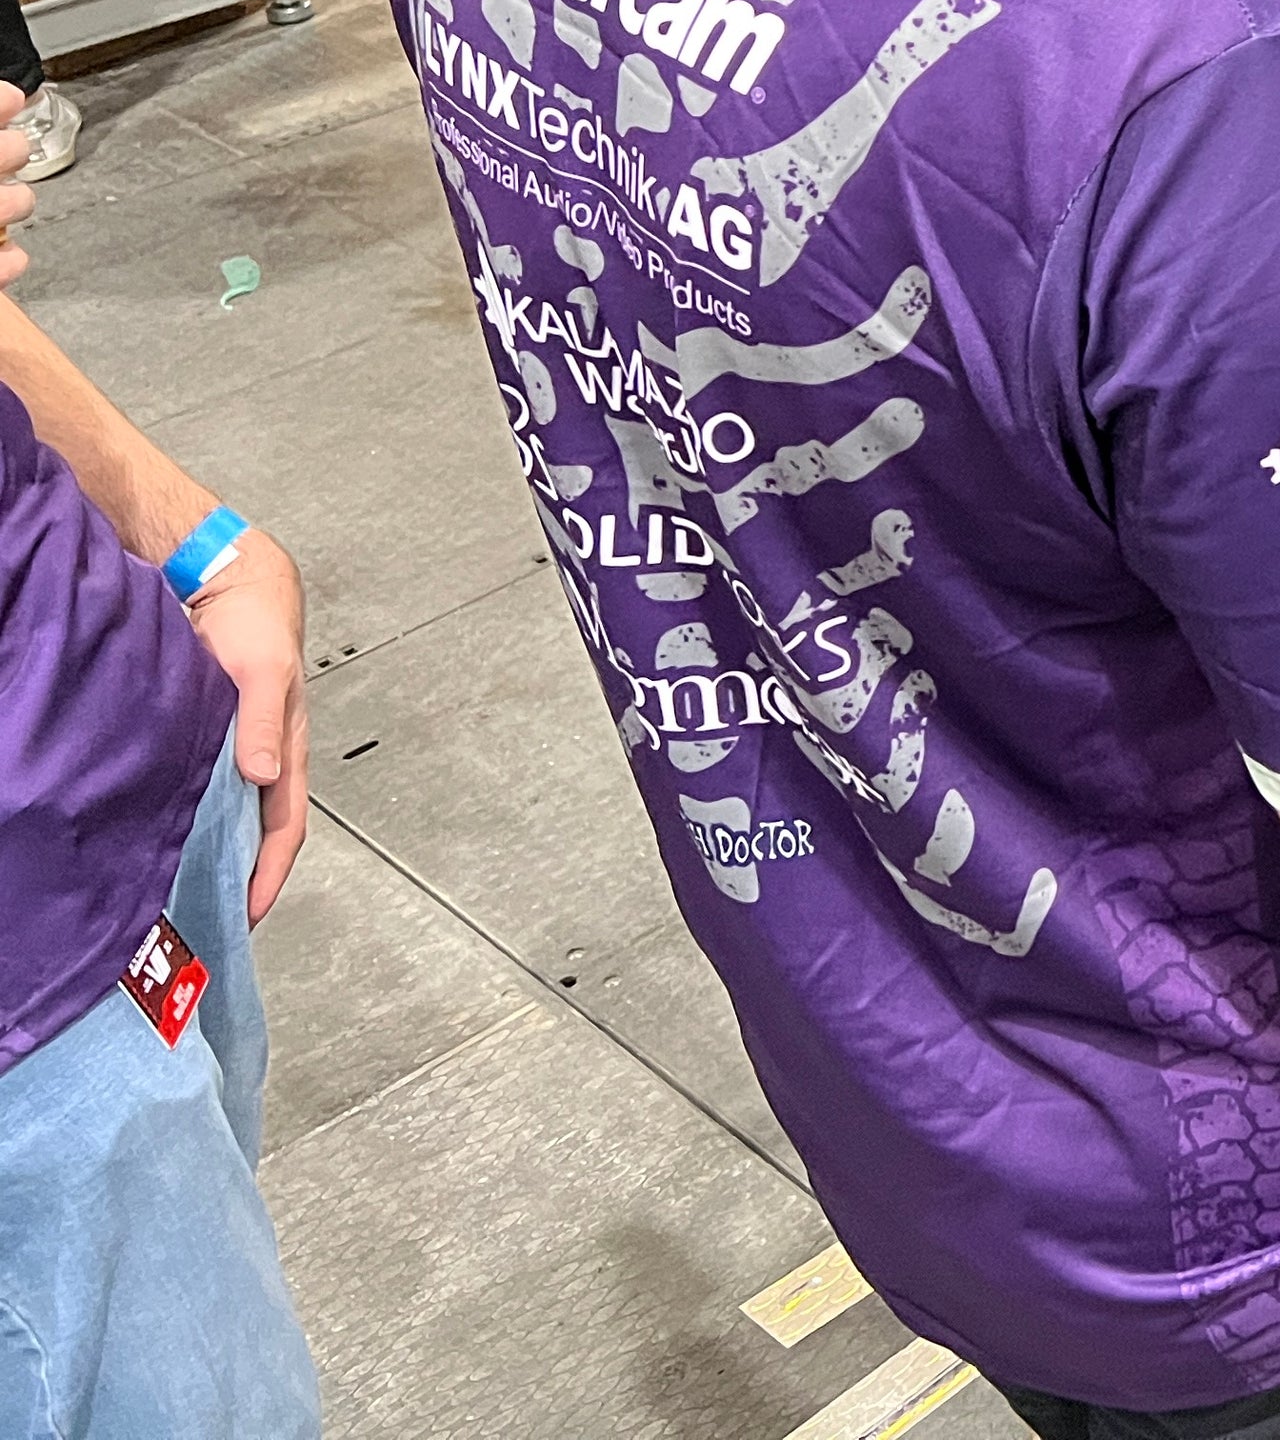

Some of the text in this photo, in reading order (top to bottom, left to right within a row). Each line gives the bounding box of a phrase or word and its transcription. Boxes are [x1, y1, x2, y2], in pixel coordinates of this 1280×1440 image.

[423, 12, 753, 271] LYNXTechnik AG
[715, 817, 816, 862] DOCTOR
